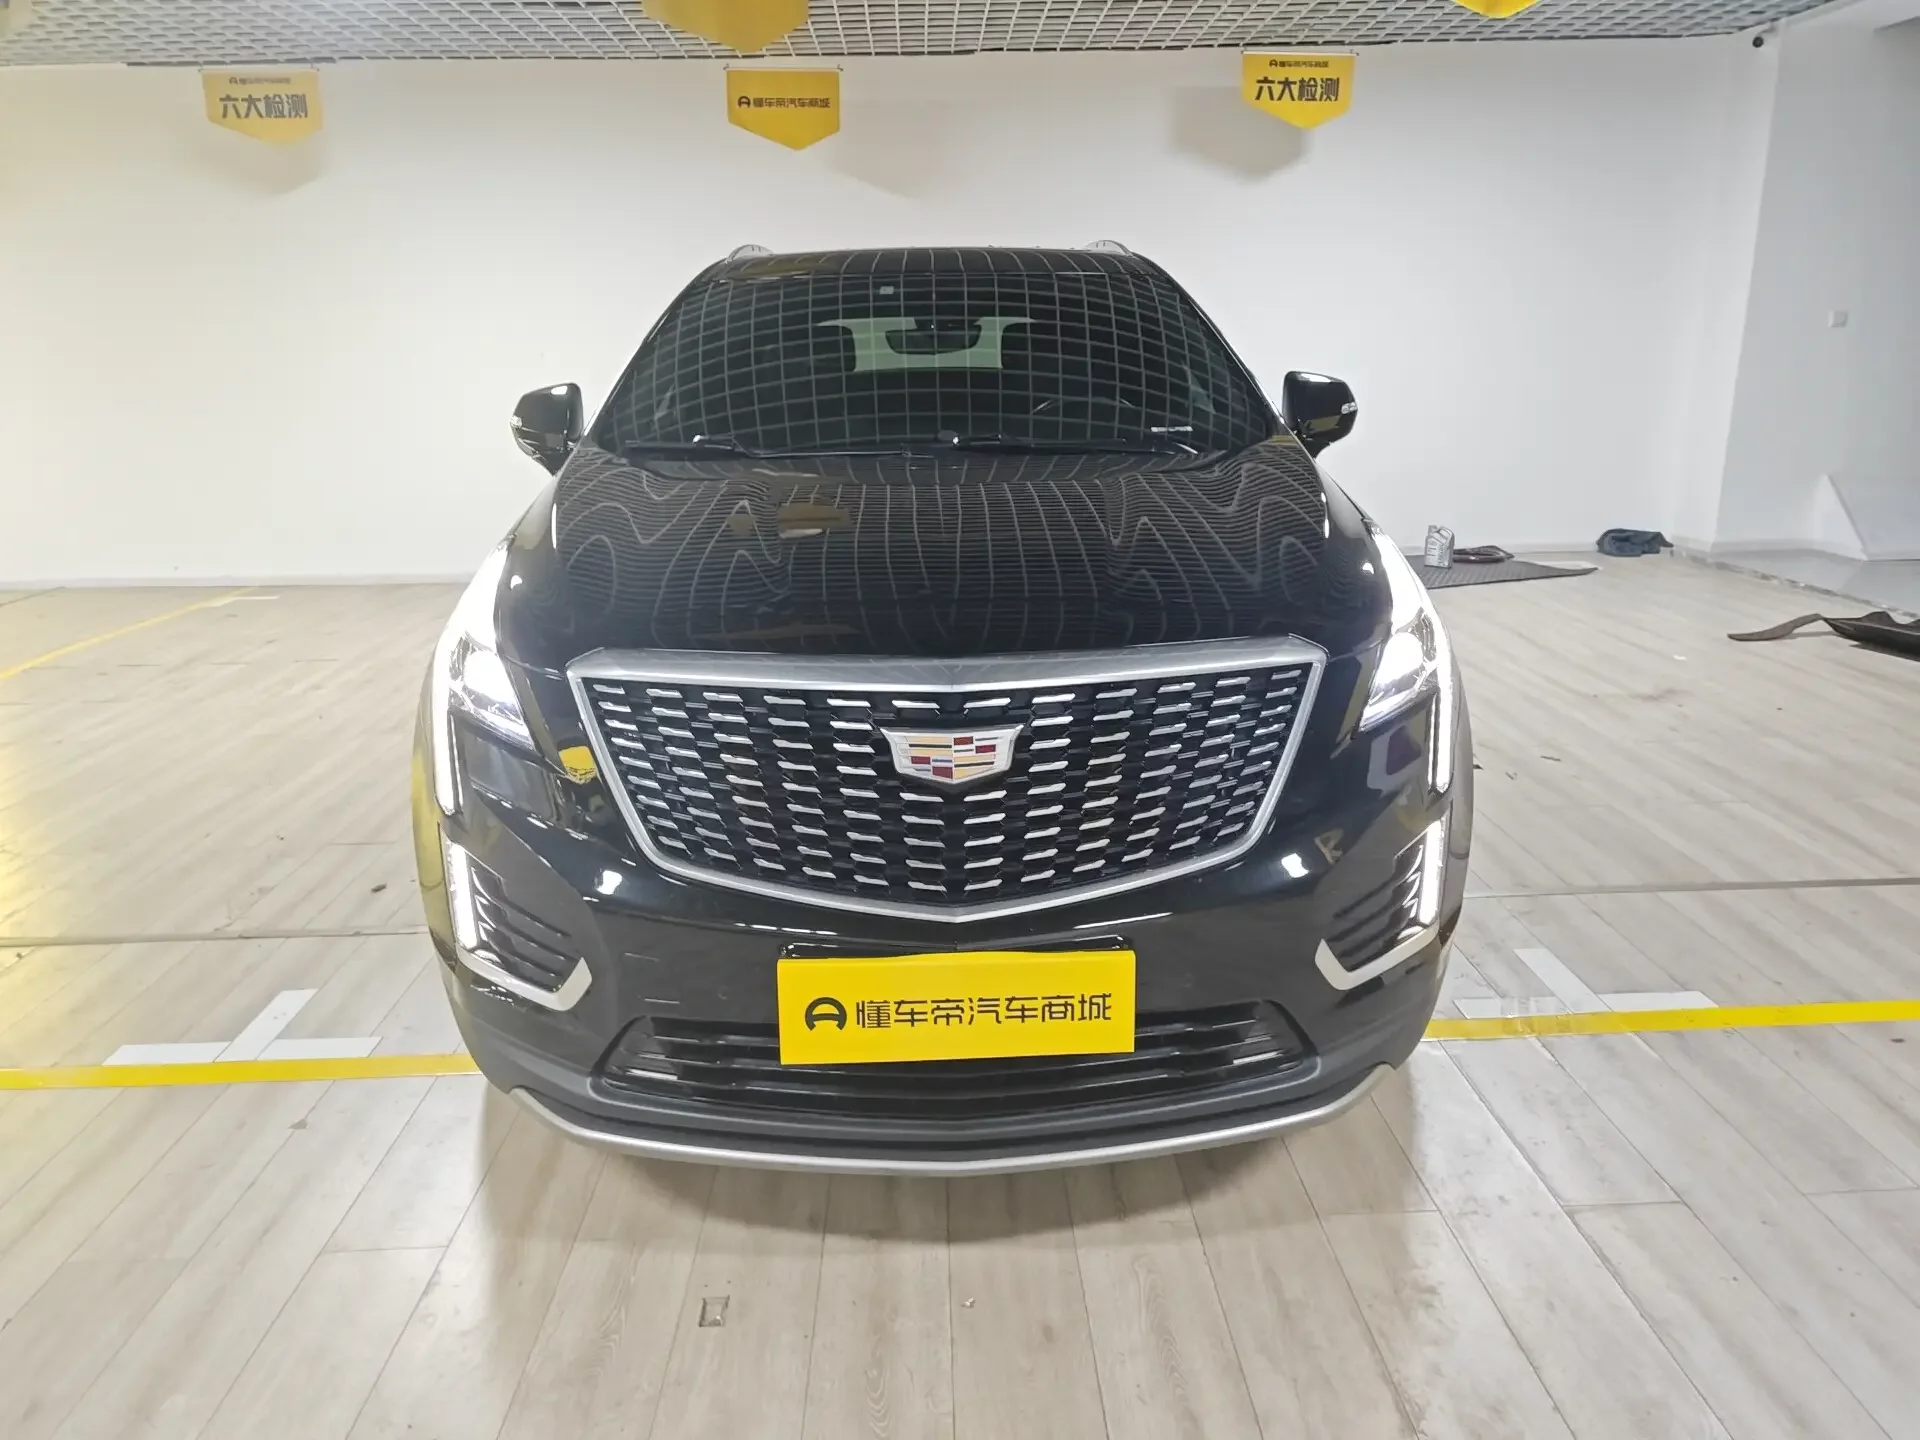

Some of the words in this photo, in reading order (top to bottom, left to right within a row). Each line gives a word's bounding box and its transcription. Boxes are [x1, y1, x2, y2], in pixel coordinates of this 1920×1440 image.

[1255, 76, 1340, 102] 六大检测
[219, 93, 308, 119] 六大检测
[855, 992, 1112, 1029] 懂车帝汽车商城
